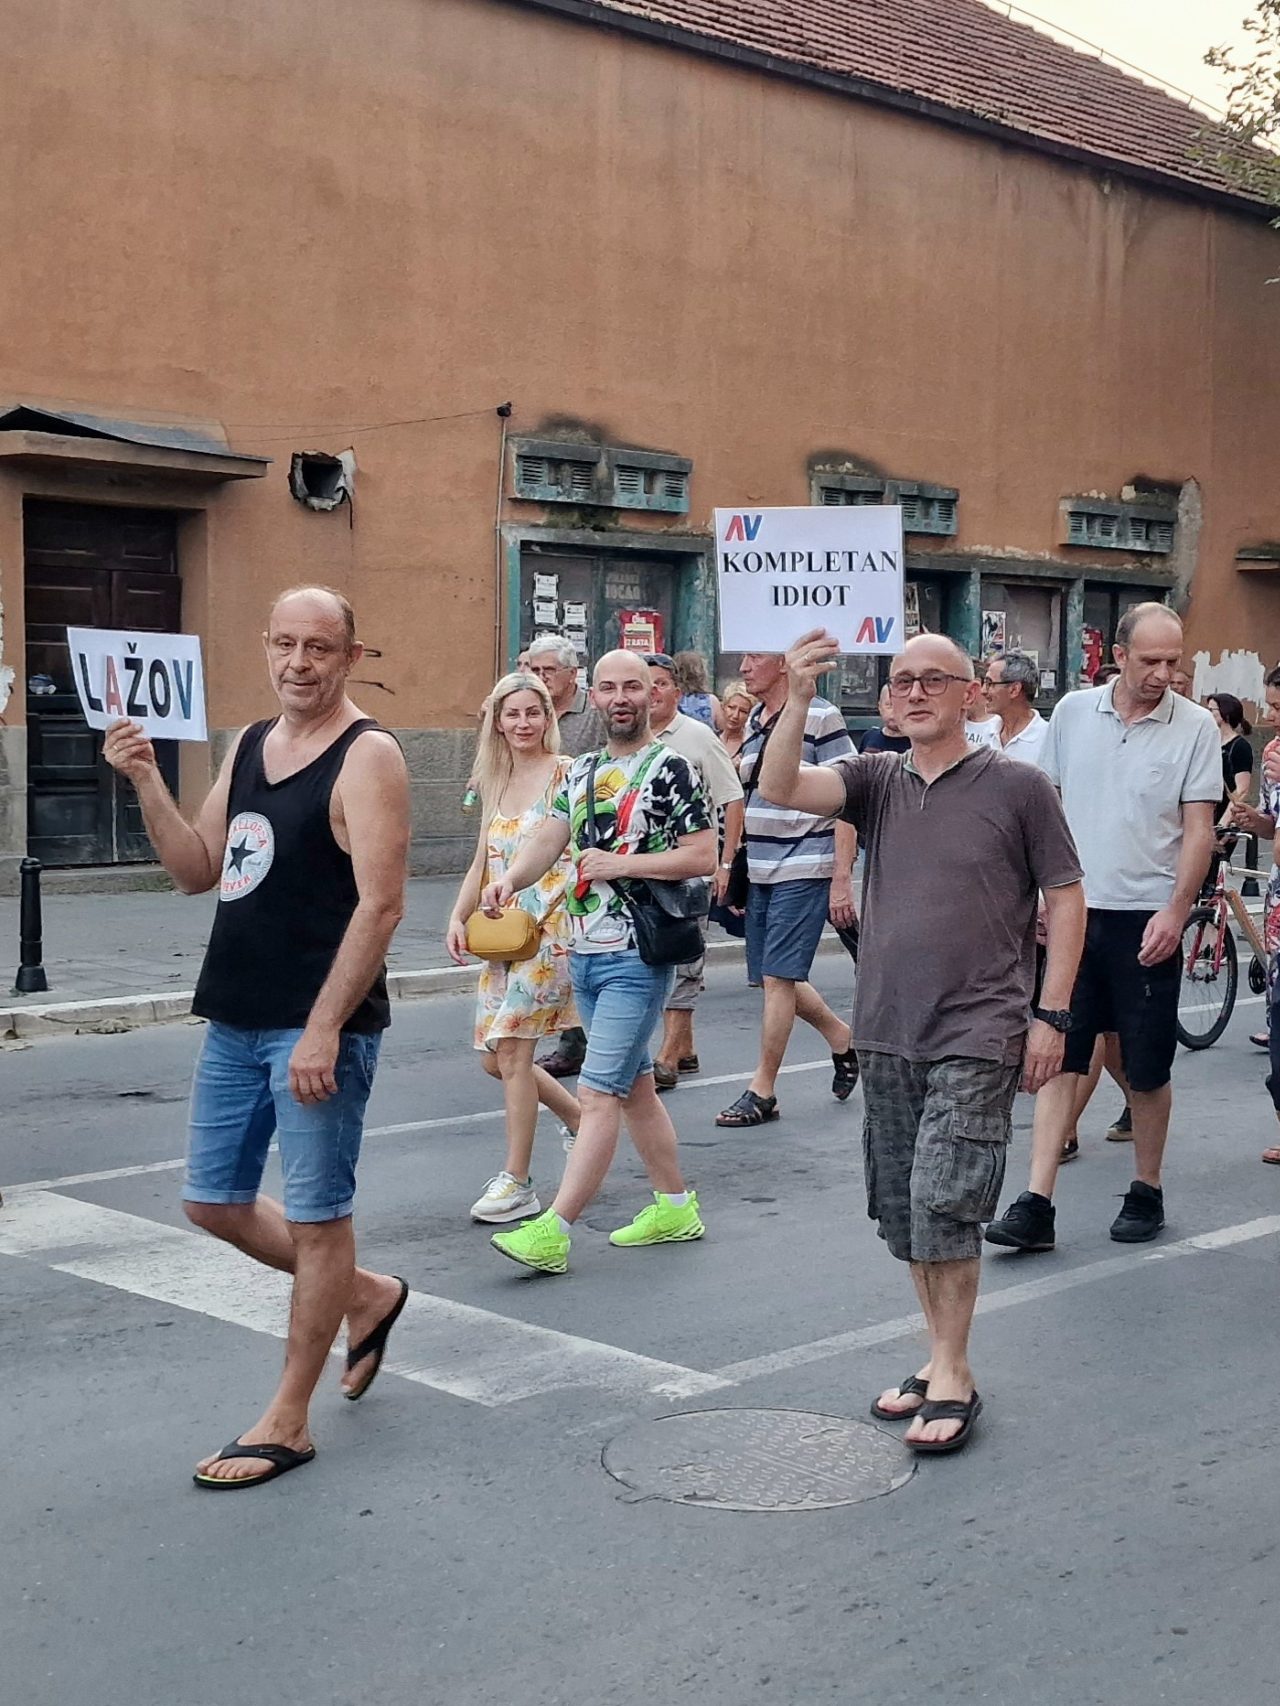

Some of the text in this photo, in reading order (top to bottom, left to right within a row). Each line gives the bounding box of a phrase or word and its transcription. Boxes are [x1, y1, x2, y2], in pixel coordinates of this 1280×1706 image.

[725, 514, 762, 541] AV
[722, 551, 898, 573] KOMPLETAN
[772, 585, 851, 607] IDIOT
[855, 616, 895, 643] AV
[79, 642, 193, 720] LAŽOV
